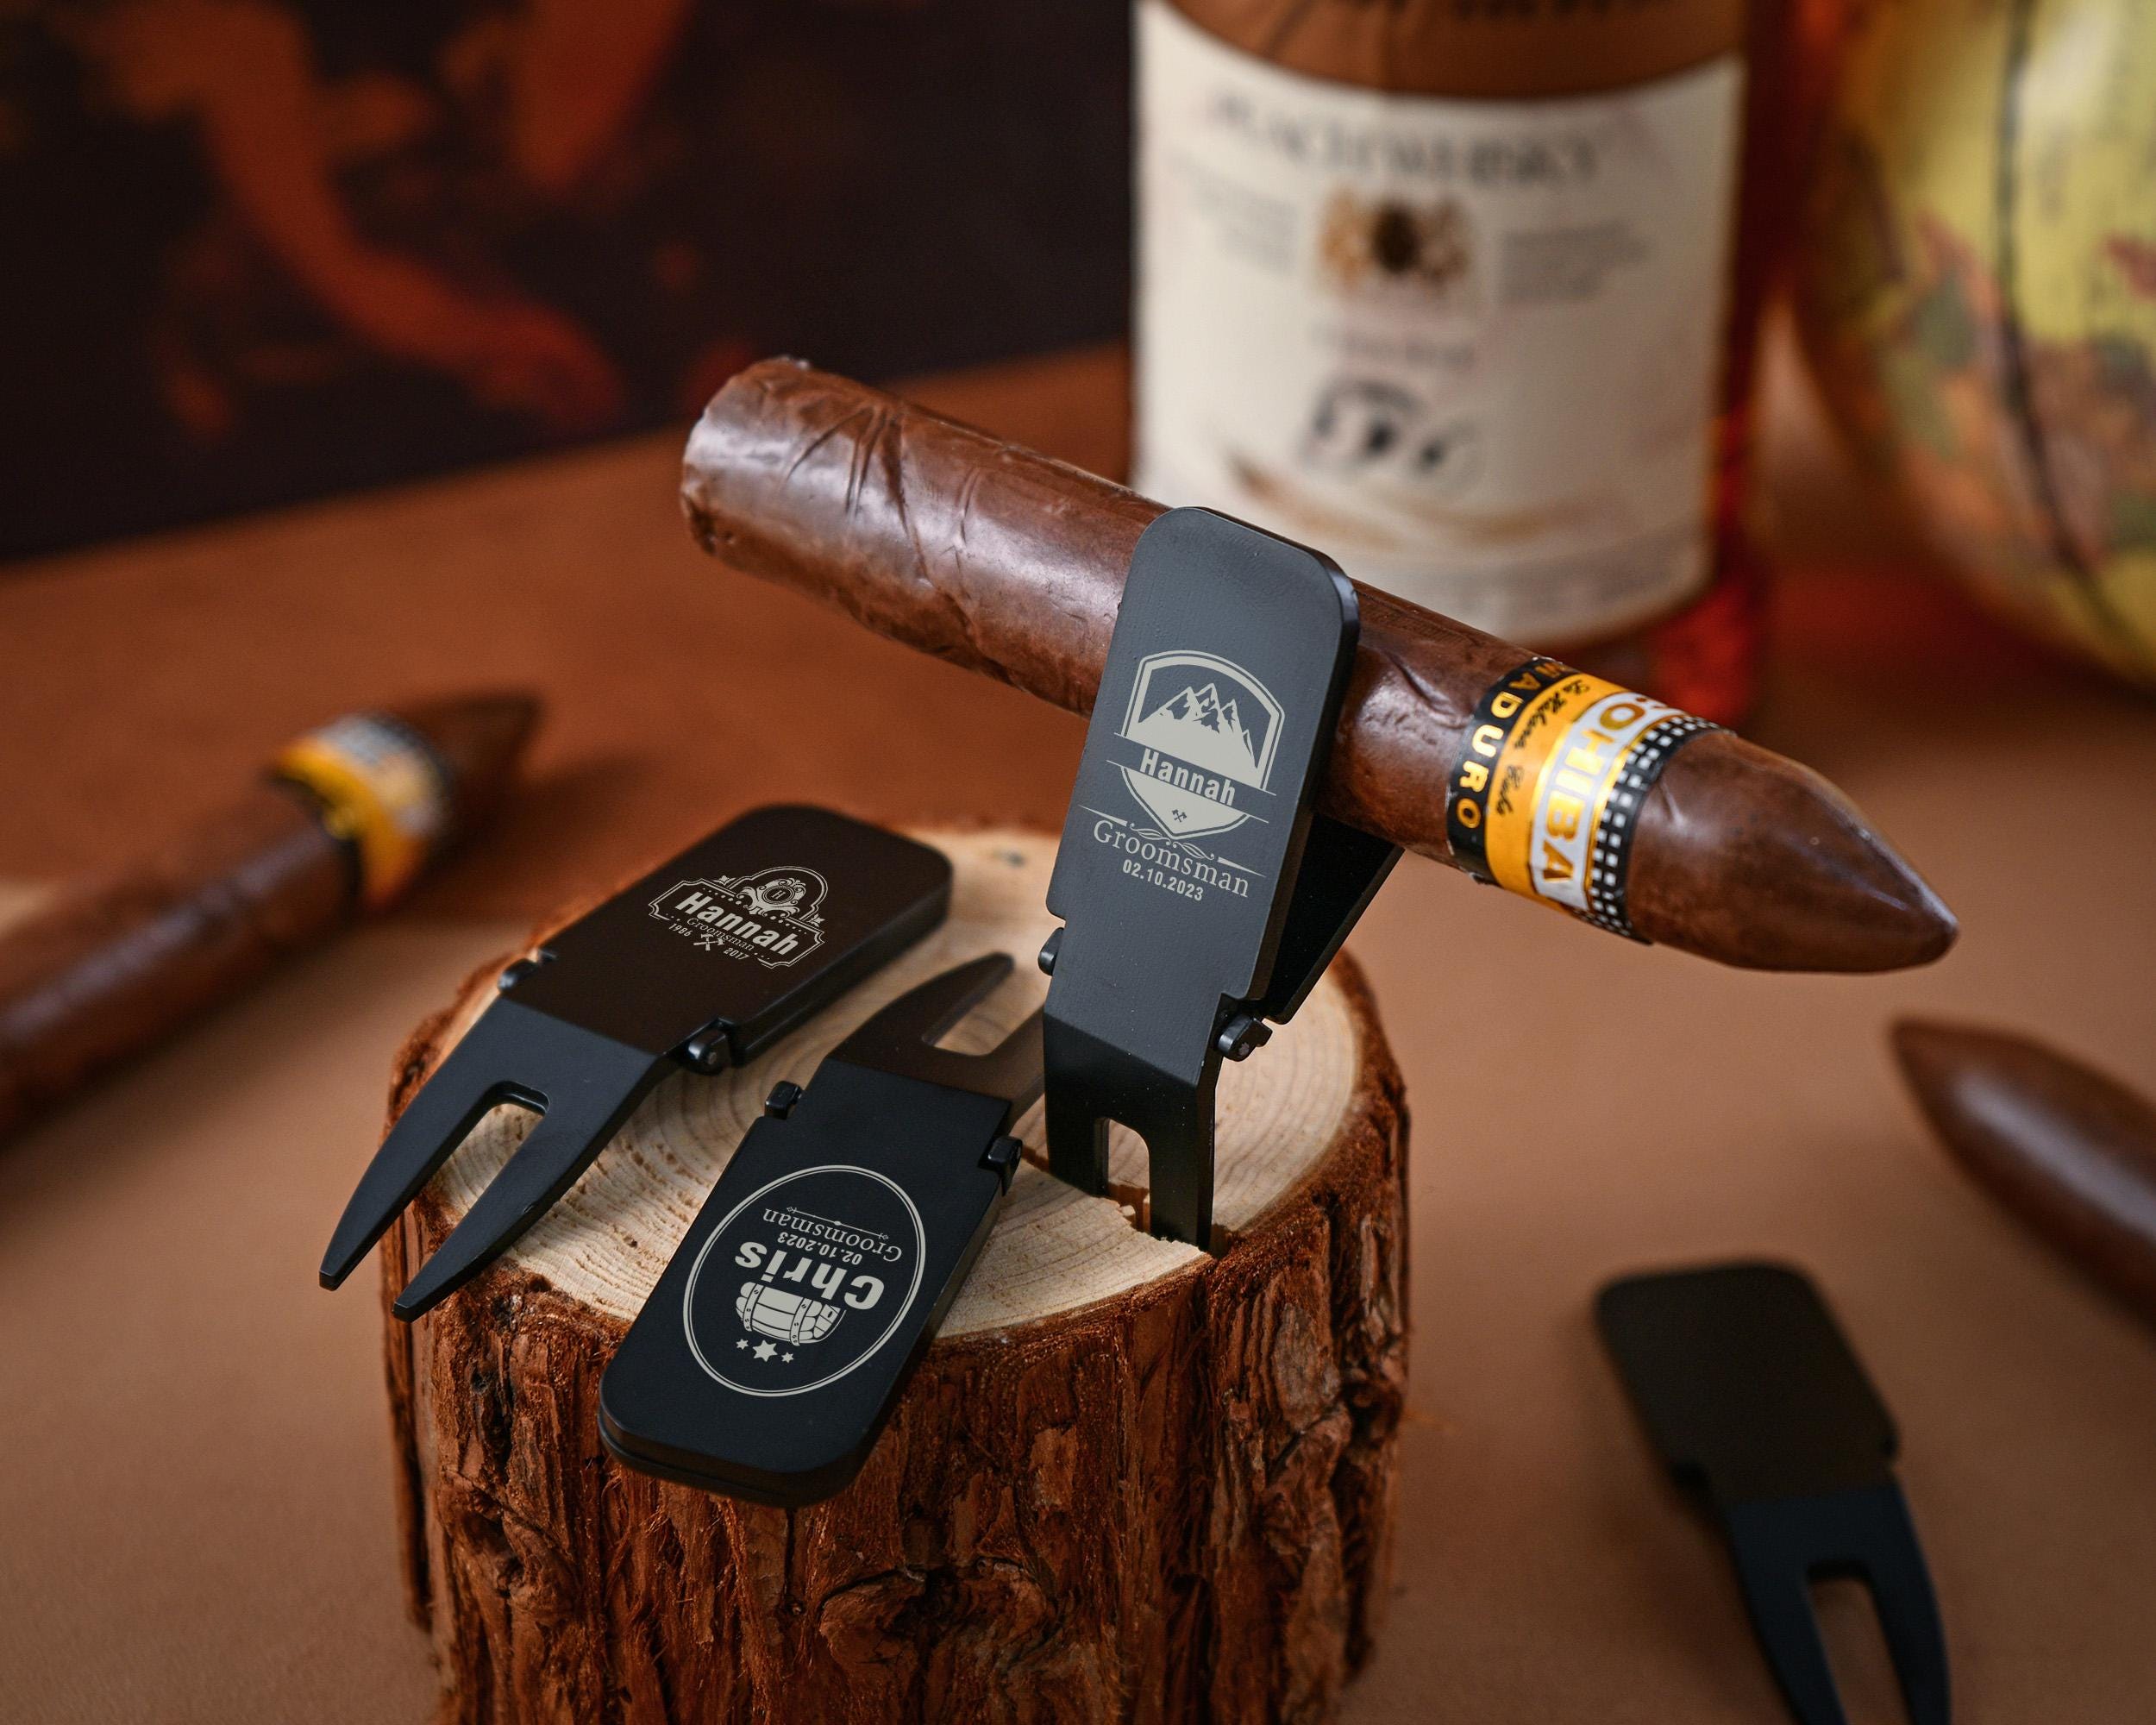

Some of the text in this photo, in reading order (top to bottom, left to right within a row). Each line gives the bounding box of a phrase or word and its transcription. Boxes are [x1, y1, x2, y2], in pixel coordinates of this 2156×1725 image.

[1457, 662, 1565, 828] MADURO
[1138, 748, 1236, 806] Hannah
[1094, 819, 1249, 898] Groomsman
[1123, 859, 1204, 901] 02.10.2023
[668, 923, 693, 937] 1986
[674, 892, 799, 956] Hannah
[686, 918, 755, 951] Groomsman
[724, 947, 750, 960] 2017
[762, 1208, 903, 1262] Groomsman
[777, 1232, 863, 1265] 02.10.2023
[735, 1241, 885, 1310] Chris
